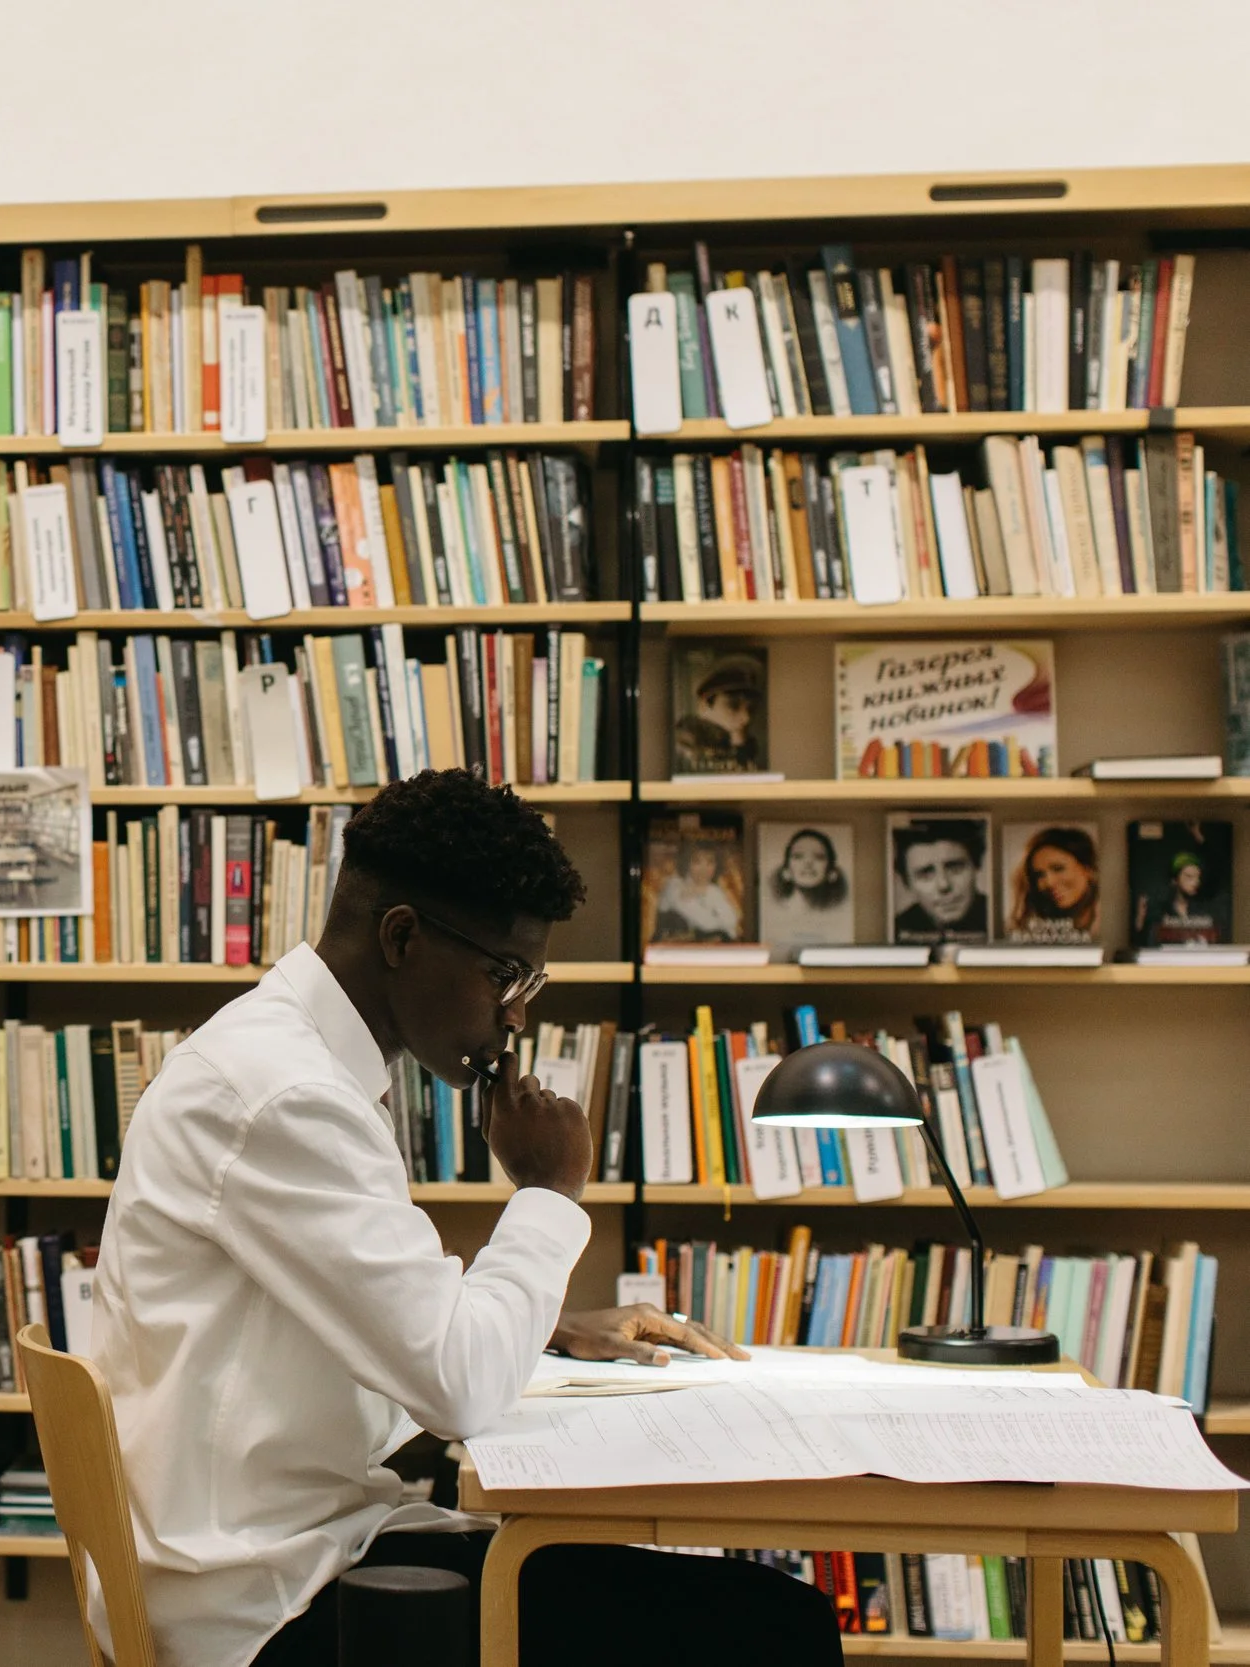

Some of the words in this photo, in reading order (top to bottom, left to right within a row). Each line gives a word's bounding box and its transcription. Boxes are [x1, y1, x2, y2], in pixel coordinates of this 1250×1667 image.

[644, 306, 663, 328] Д
[725, 305, 739, 320] К
[862, 479, 871, 496] Т
[246, 496, 257, 514] Г
[877, 645, 996, 683] Галерея
[260, 673, 275, 693] Р
[862, 665, 1004, 710] книжных
[869, 687, 999, 733] новинок!
[80, 1282, 92, 1301] В
